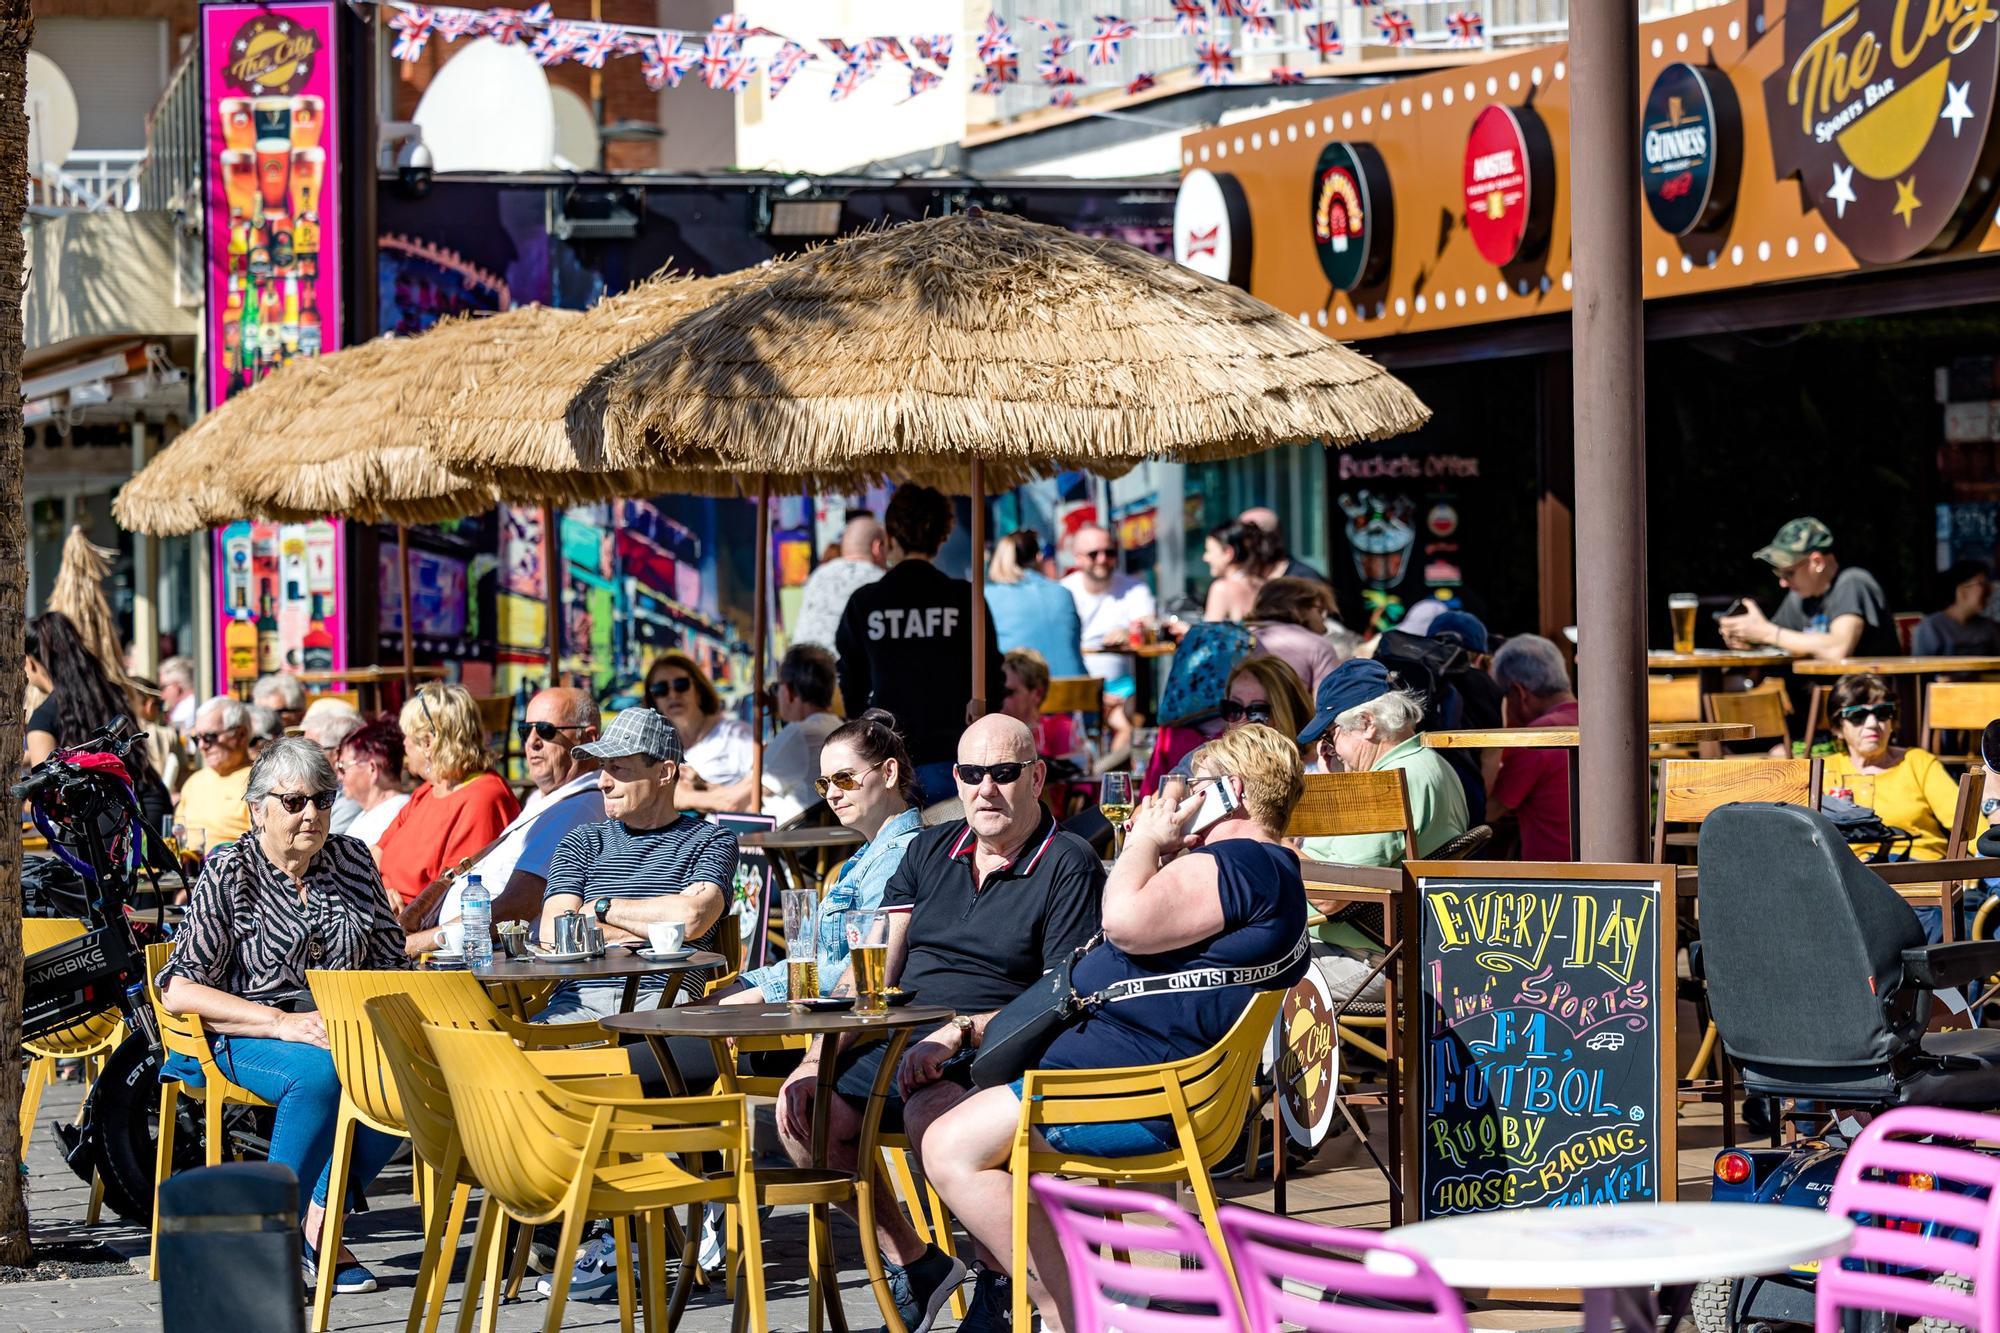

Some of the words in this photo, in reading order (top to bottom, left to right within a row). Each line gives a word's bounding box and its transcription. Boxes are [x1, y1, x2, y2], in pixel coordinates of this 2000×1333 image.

[1788, 6, 1882, 135] The
[1645, 126, 1707, 163] GUINNESS
[868, 607, 959, 640] STAFF
[1168, 970, 1227, 989] ISLAND
[1233, 964, 1278, 983] RIVER
[1513, 964, 1649, 1026] SPORTS
[1307, 1021, 1332, 1062] City
[126, 1062, 144, 1086] CST
